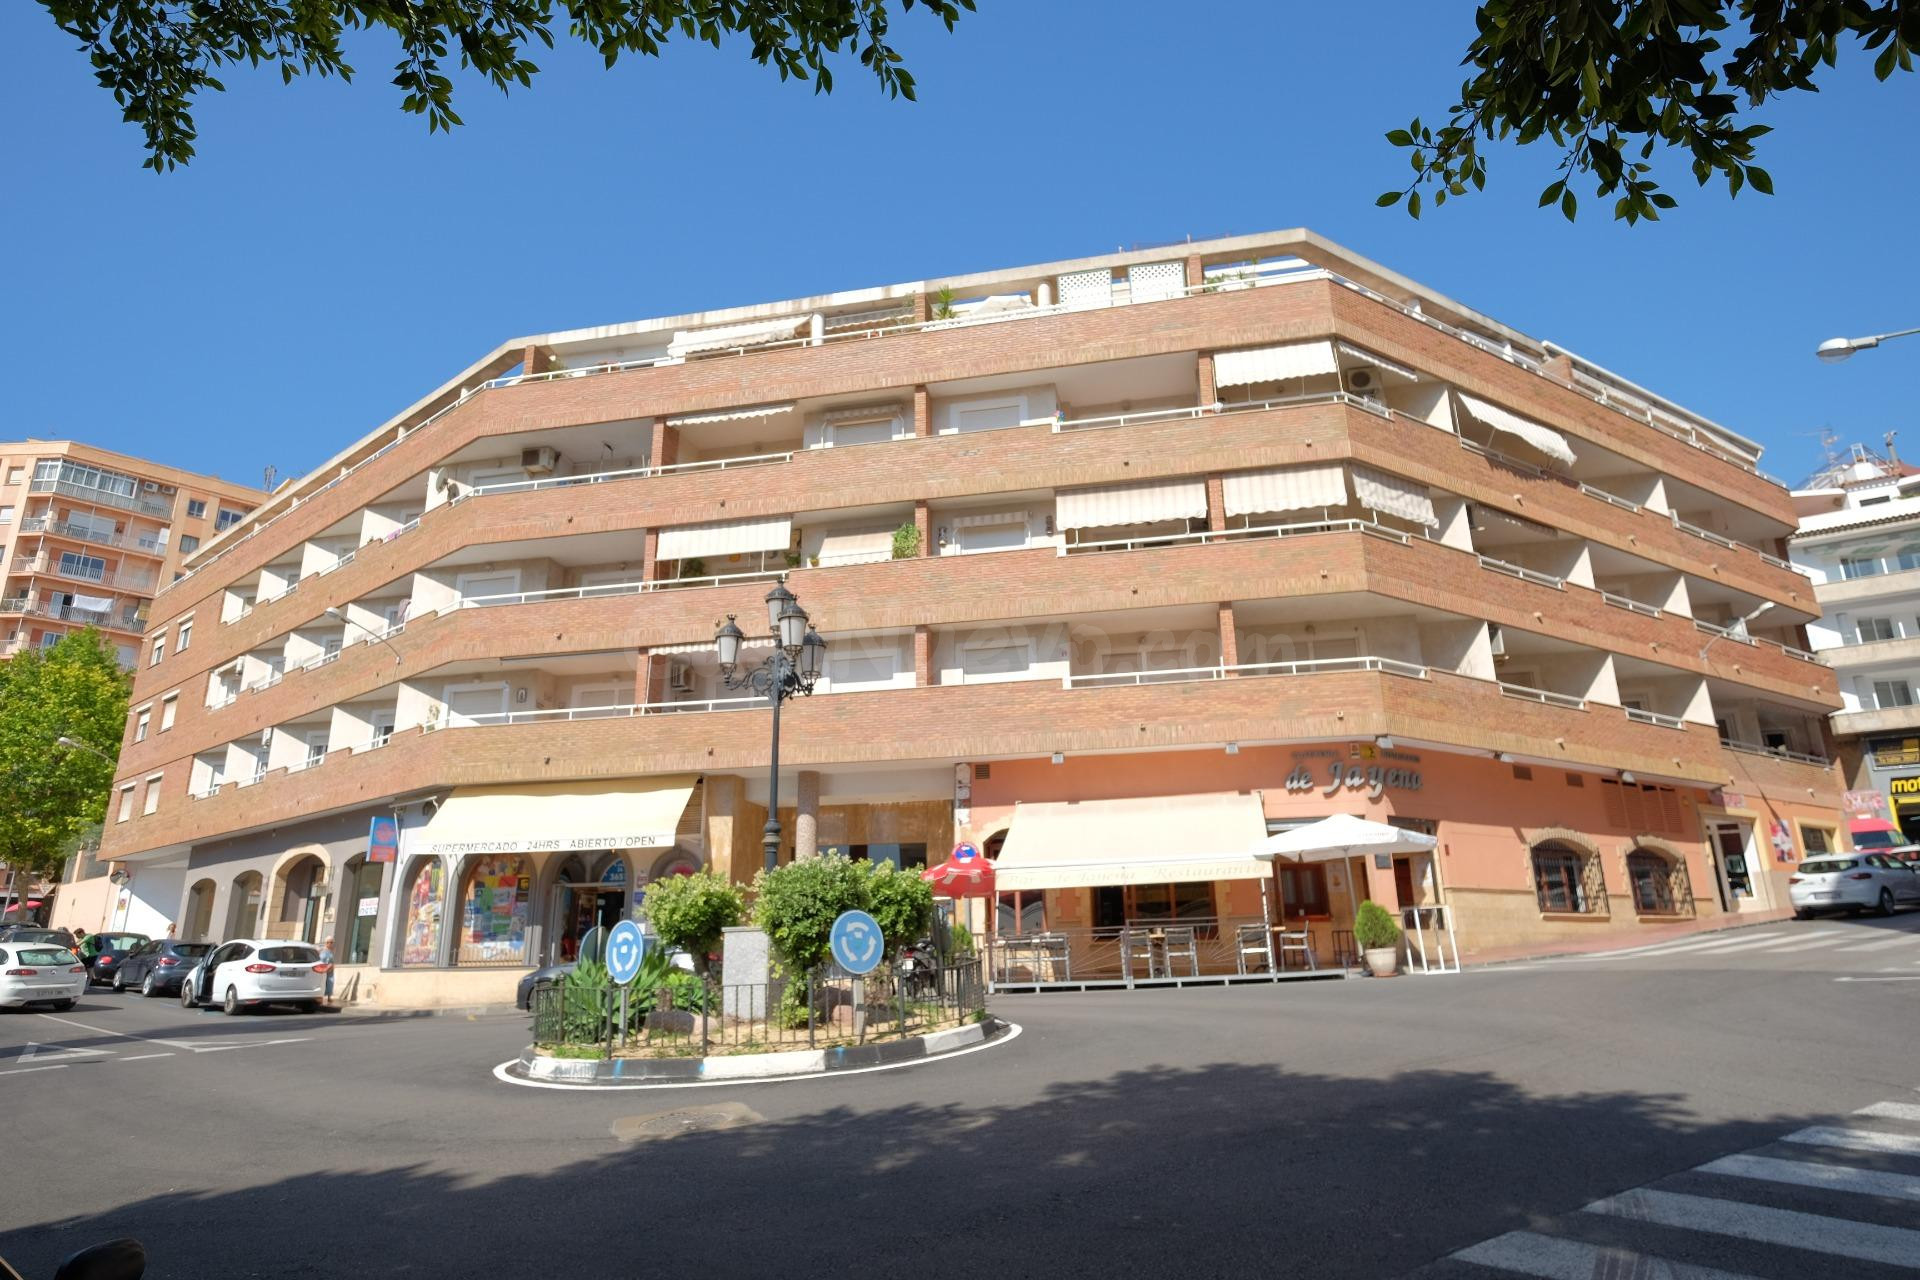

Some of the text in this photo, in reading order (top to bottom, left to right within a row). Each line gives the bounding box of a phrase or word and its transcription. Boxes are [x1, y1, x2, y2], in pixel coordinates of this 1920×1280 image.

[1284, 764, 1313, 790] de
[431, 841, 518, 854] SUPERMERCADO
[527, 840, 560, 851] 24HRS
[570, 837, 616, 849] ABIERTO
[625, 835, 656, 848] OPEN
